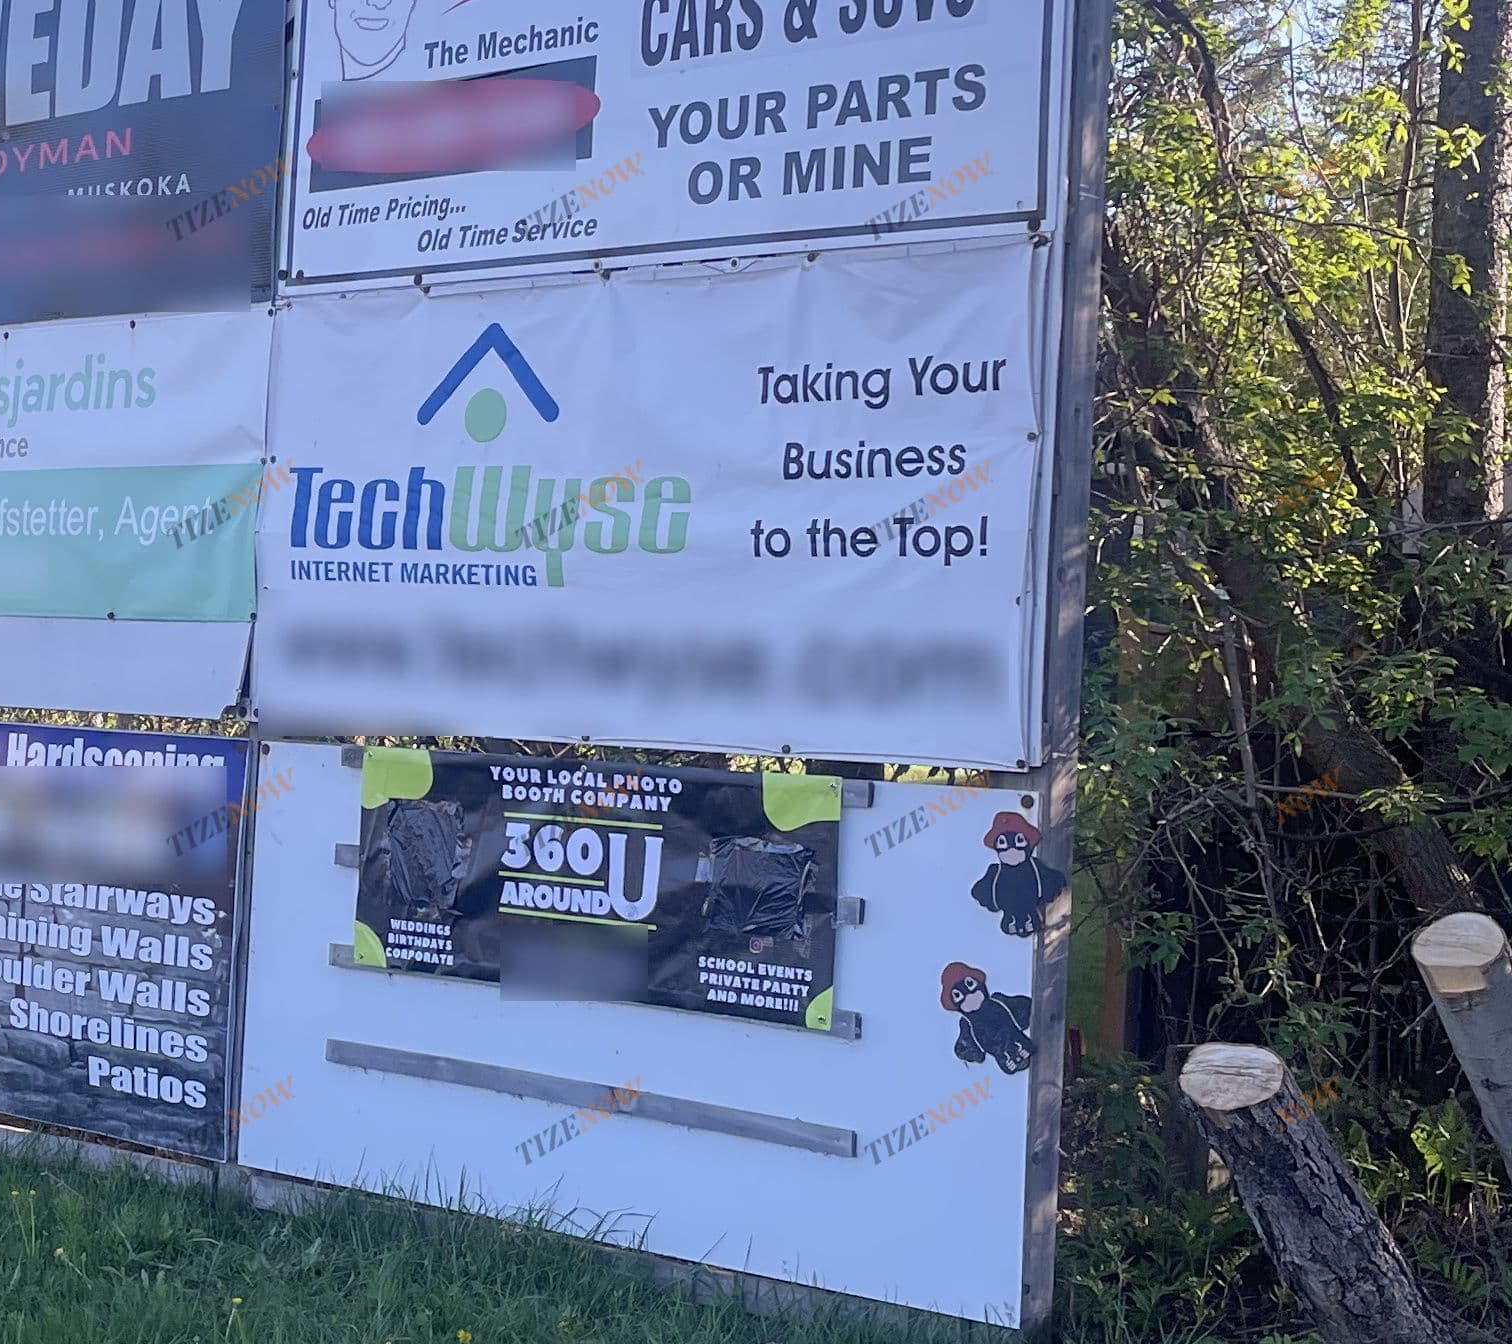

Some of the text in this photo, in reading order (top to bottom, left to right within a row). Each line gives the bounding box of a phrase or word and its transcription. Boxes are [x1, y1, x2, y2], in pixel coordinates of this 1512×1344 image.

[424, 17, 599, 68] The Mechanic
[648, 90, 787, 148] YOUR
[806, 64, 986, 129] PARTS
[688, 136, 932, 205] OR MINE
[302, 194, 466, 230] Old Time Pricing...
[417, 215, 598, 252] Old Time Service
[757, 356, 1007, 409] Taking Your
[783, 441, 967, 480] Business
[113, 496, 214, 546] Agent
[289, 465, 692, 588] TechWyse
[750, 516, 989, 566] to the Top!
[291, 560, 538, 587] INTERNET MARKETING
[489, 766, 682, 794] YOUR LOCAL PHOTO
[502, 784, 671, 812] BOOTH COMPANY
[501, 822, 603, 875] 360
[500, 833, 664, 920] AROUND U
[30, 883, 216, 925] Stairways
[101, 925, 214, 971] Walls
[388, 932, 452, 950] BIRTHDAYS
[390, 919, 451, 936] WEDDINGS
[386, 947, 454, 965] CORPORATE
[698, 956, 813, 982] SCHOOL EVENTS
[98, 969, 210, 1016] Walls
[699, 971, 809, 996] PRIVATE PARTY
[707, 989, 799, 1012] AND MORE!!!
[9, 997, 208, 1063] Shorelines
[88, 1056, 206, 1108] Patios
